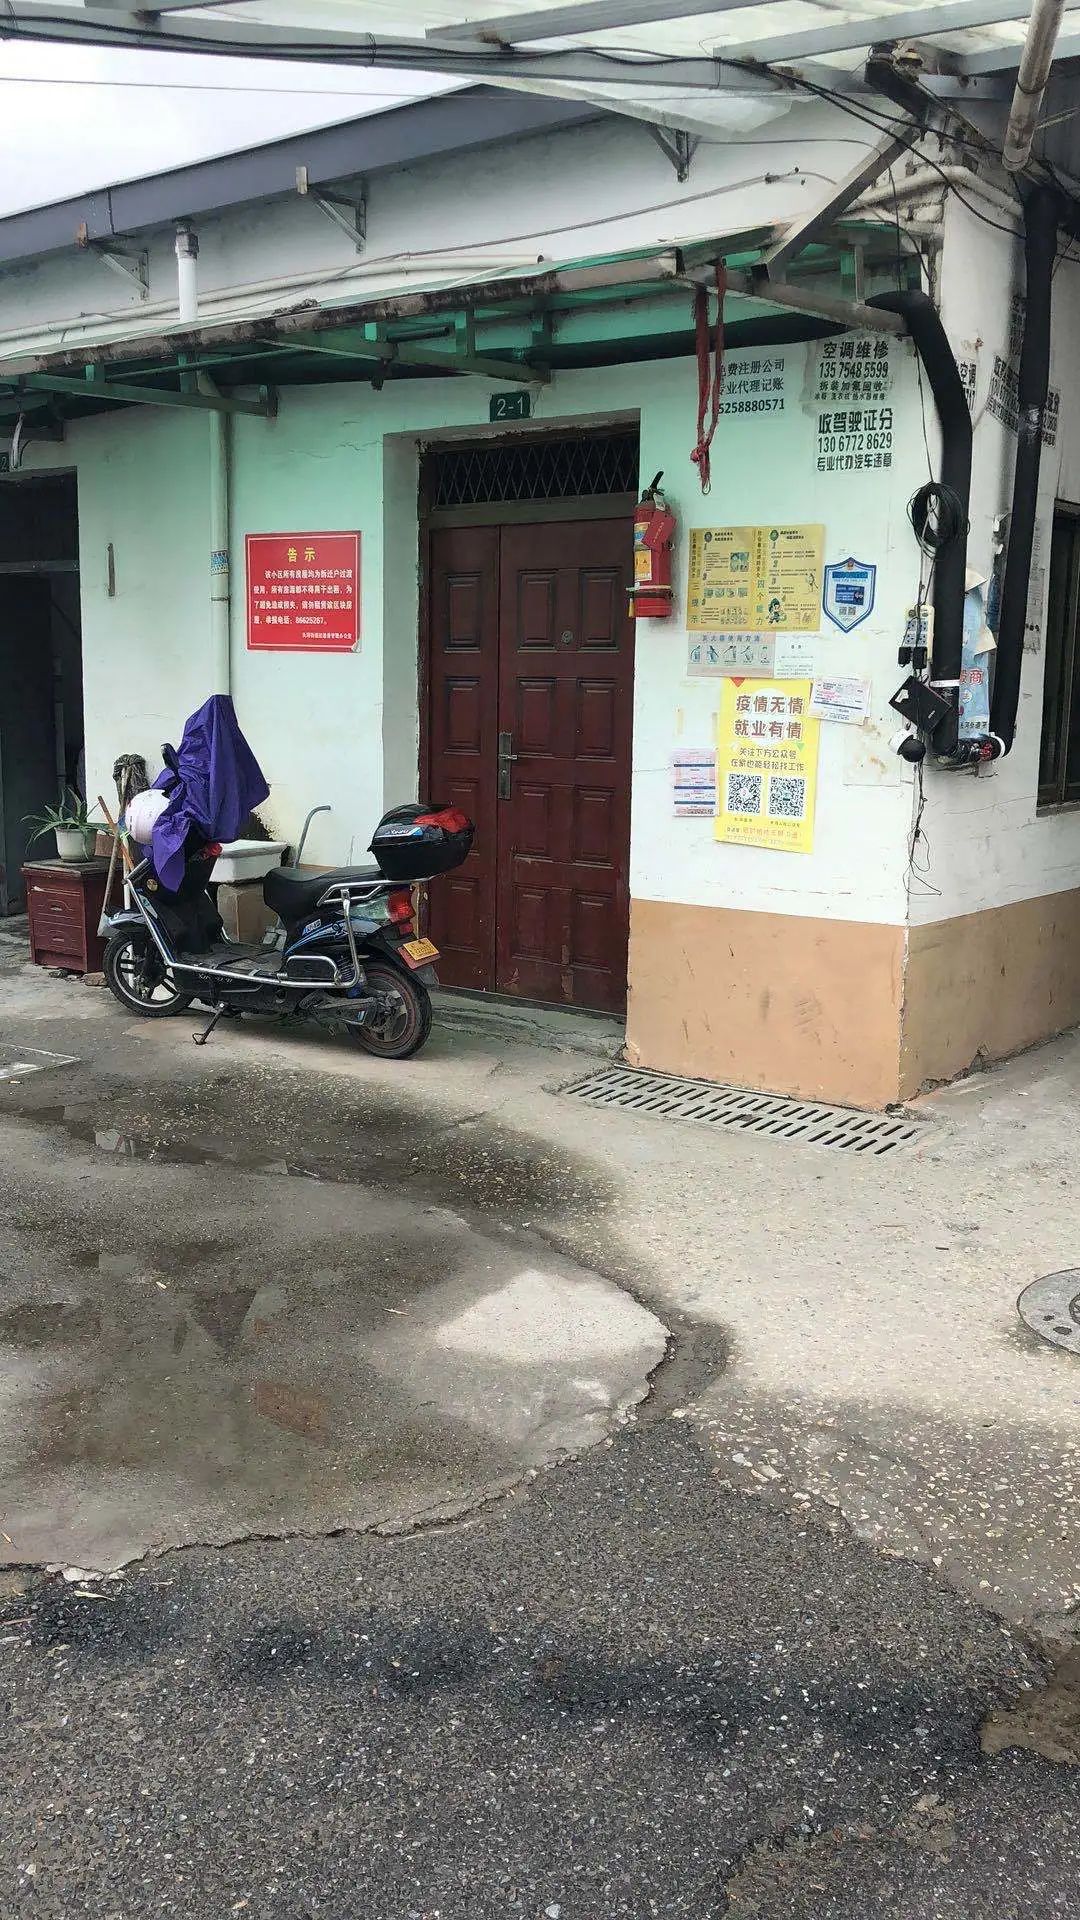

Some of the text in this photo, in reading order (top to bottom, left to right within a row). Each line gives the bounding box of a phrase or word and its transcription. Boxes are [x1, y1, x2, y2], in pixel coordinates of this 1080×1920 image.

[823, 340, 889, 359] 空调维修
[820, 362, 837, 378] 135
[839, 362, 862, 378] 7548
[497, 397, 524, 416] 2-1
[818, 407, 894, 434] 收驾驶证分
[818, 432, 893, 453] 130 6772 8629
[287, 547, 316, 563] 告示
[736, 694, 804, 715] 疫情无情
[734, 719, 802, 740] 就业有情
